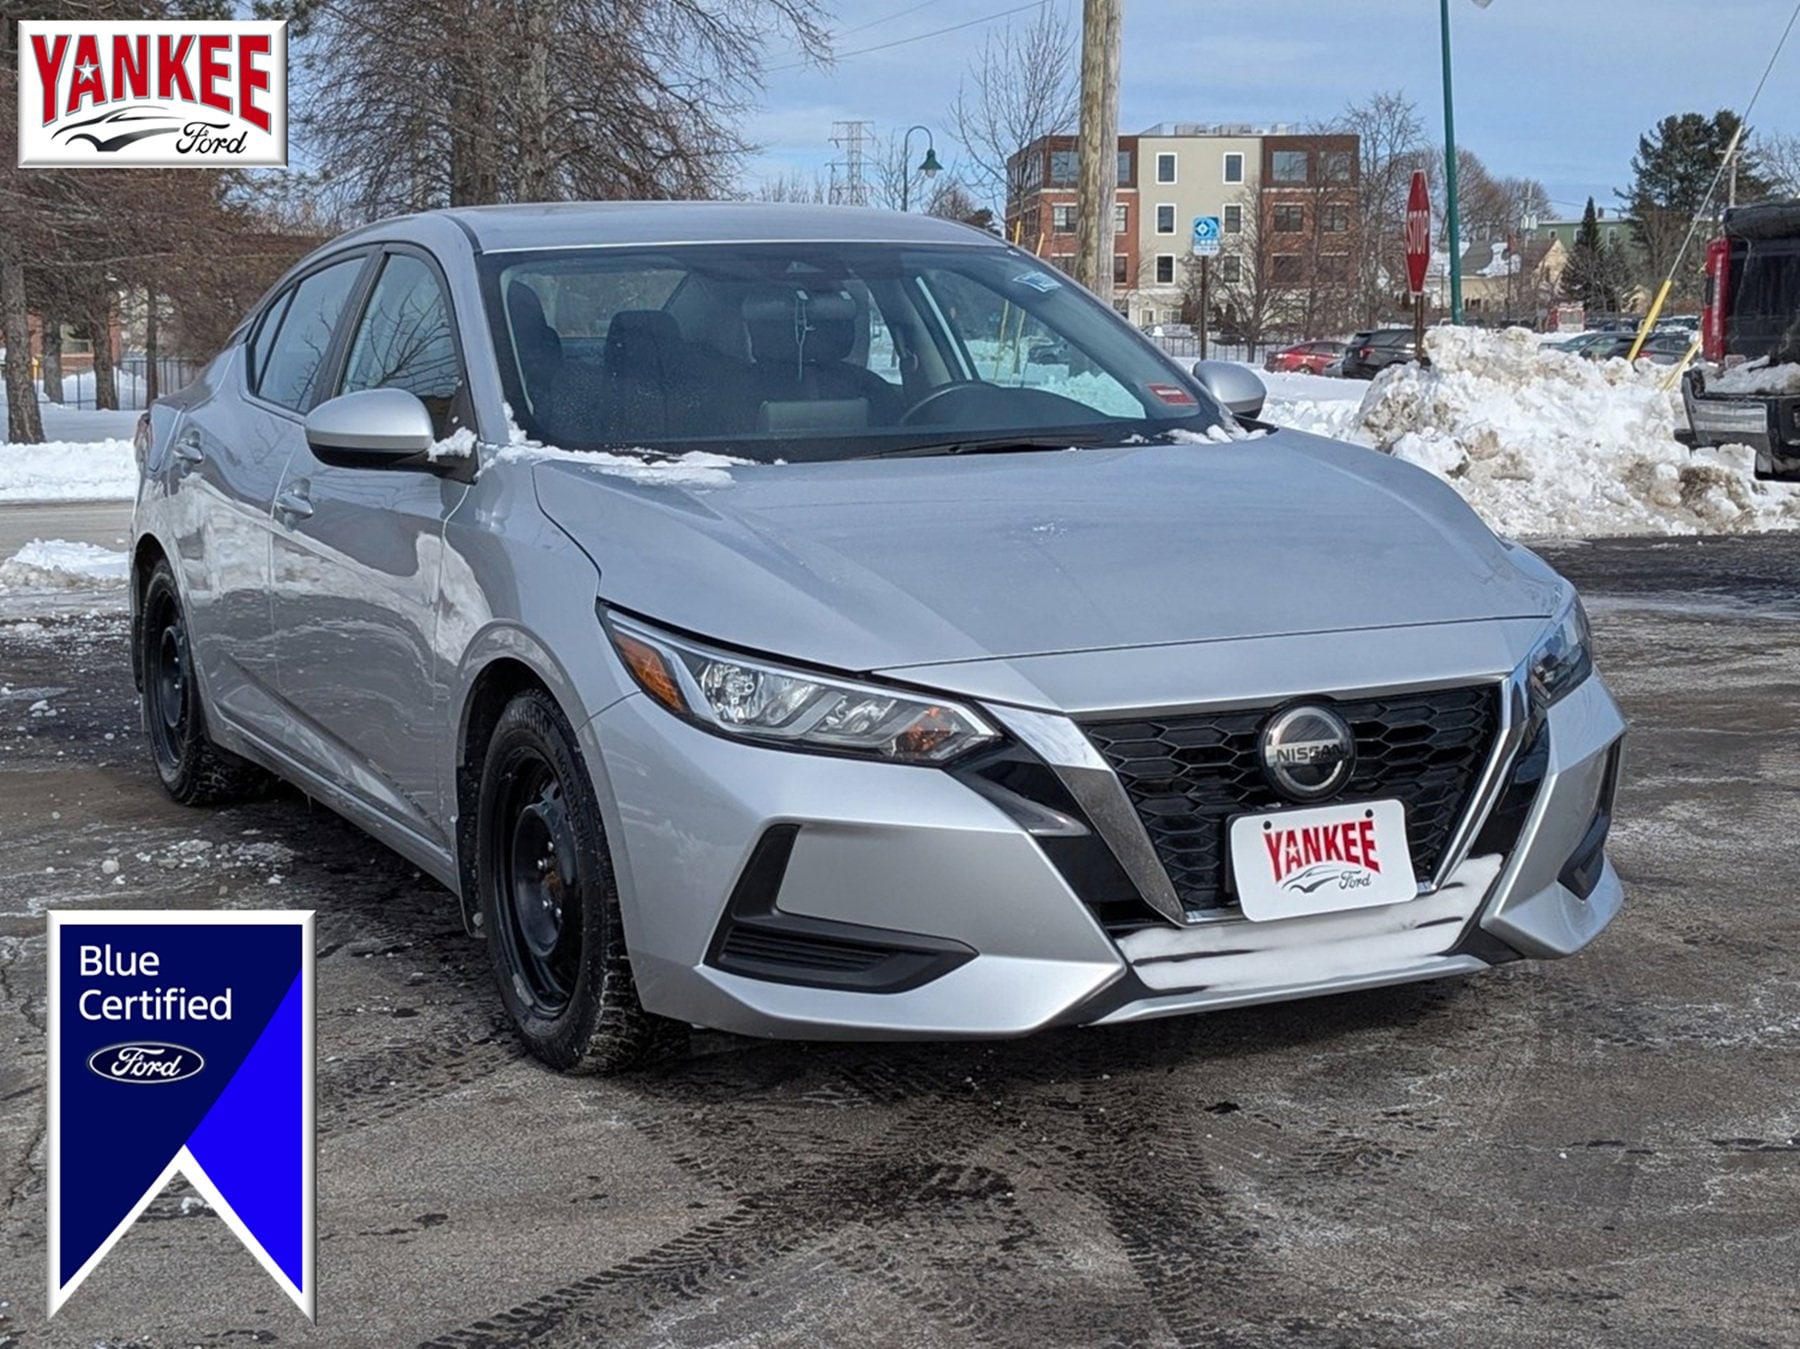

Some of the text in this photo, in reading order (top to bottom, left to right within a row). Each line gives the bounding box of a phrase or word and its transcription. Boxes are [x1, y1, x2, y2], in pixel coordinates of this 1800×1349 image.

[1408, 209, 1428, 255] STOP
[1276, 743, 1345, 763] NISSAN
[1264, 819, 1381, 883] YANKEE
[1338, 869, 1371, 890] Ford
